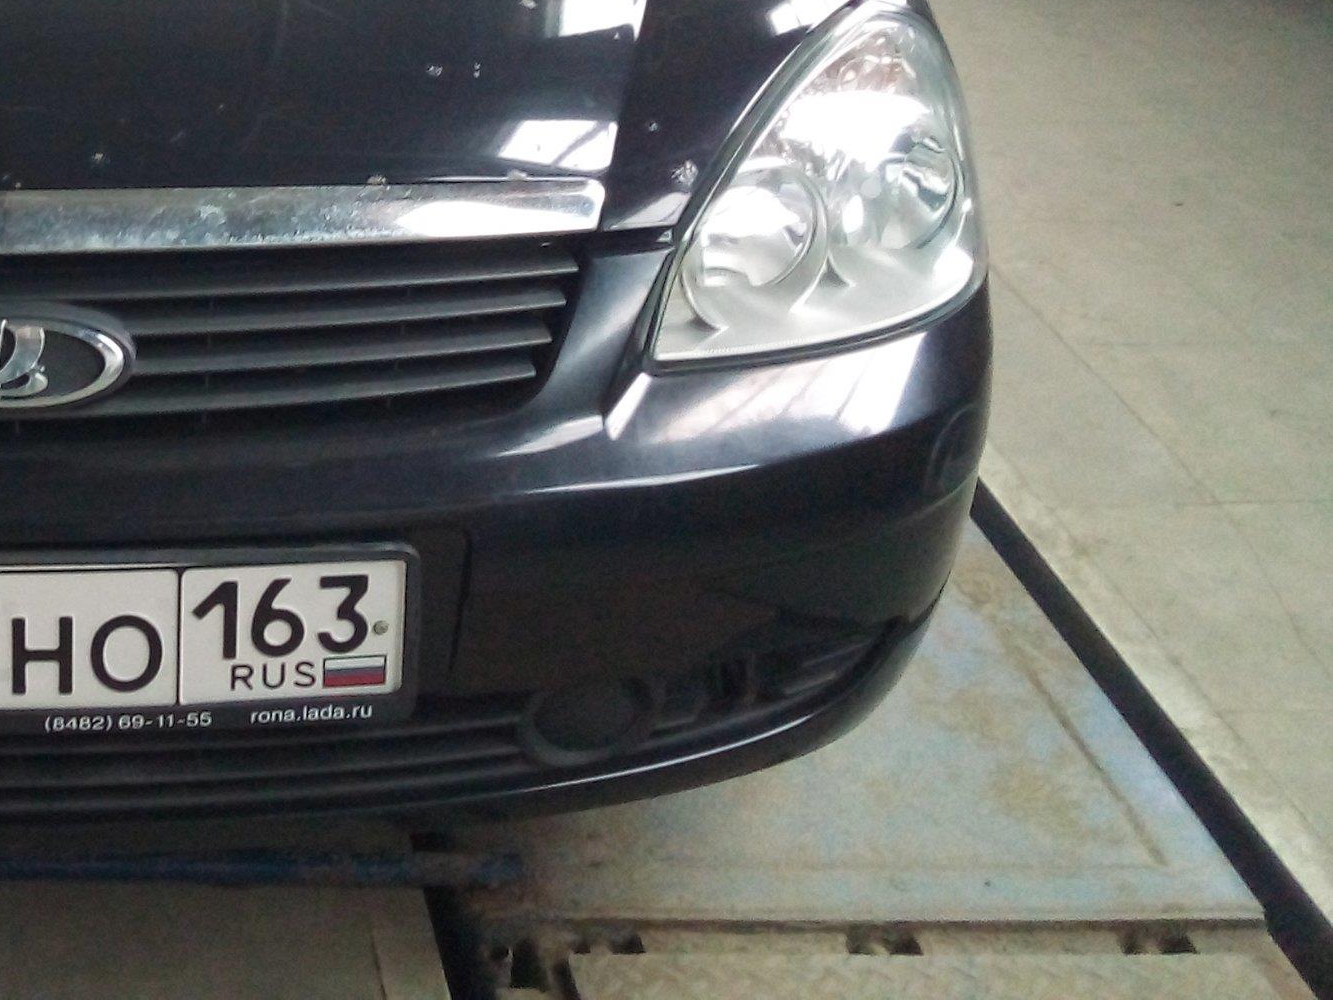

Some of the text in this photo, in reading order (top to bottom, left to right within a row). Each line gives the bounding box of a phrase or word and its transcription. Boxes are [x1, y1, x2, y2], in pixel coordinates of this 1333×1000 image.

[192, 575, 370, 659] 163
[230, 660, 315, 692] RUS
[44, 711, 213, 732] (8482) 69-11-55
[250, 702, 373, 725] rona.lada.ru
